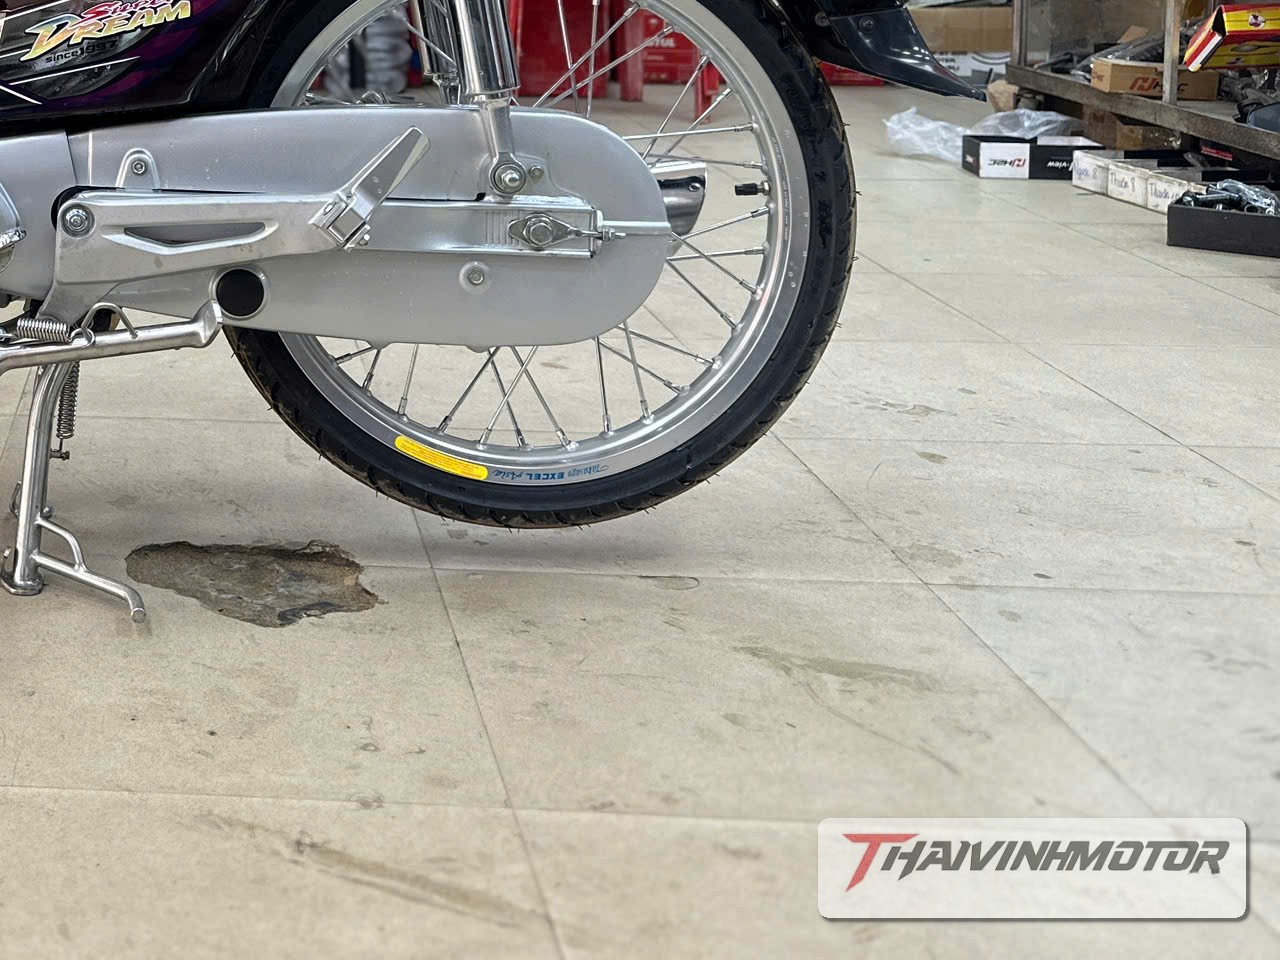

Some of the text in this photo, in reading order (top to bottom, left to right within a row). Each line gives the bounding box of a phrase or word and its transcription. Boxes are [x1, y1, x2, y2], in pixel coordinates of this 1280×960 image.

[20, 0, 192, 62] DREAM
[491, 469, 523, 481] Asia
[526, 471, 565, 480] EXCEL
